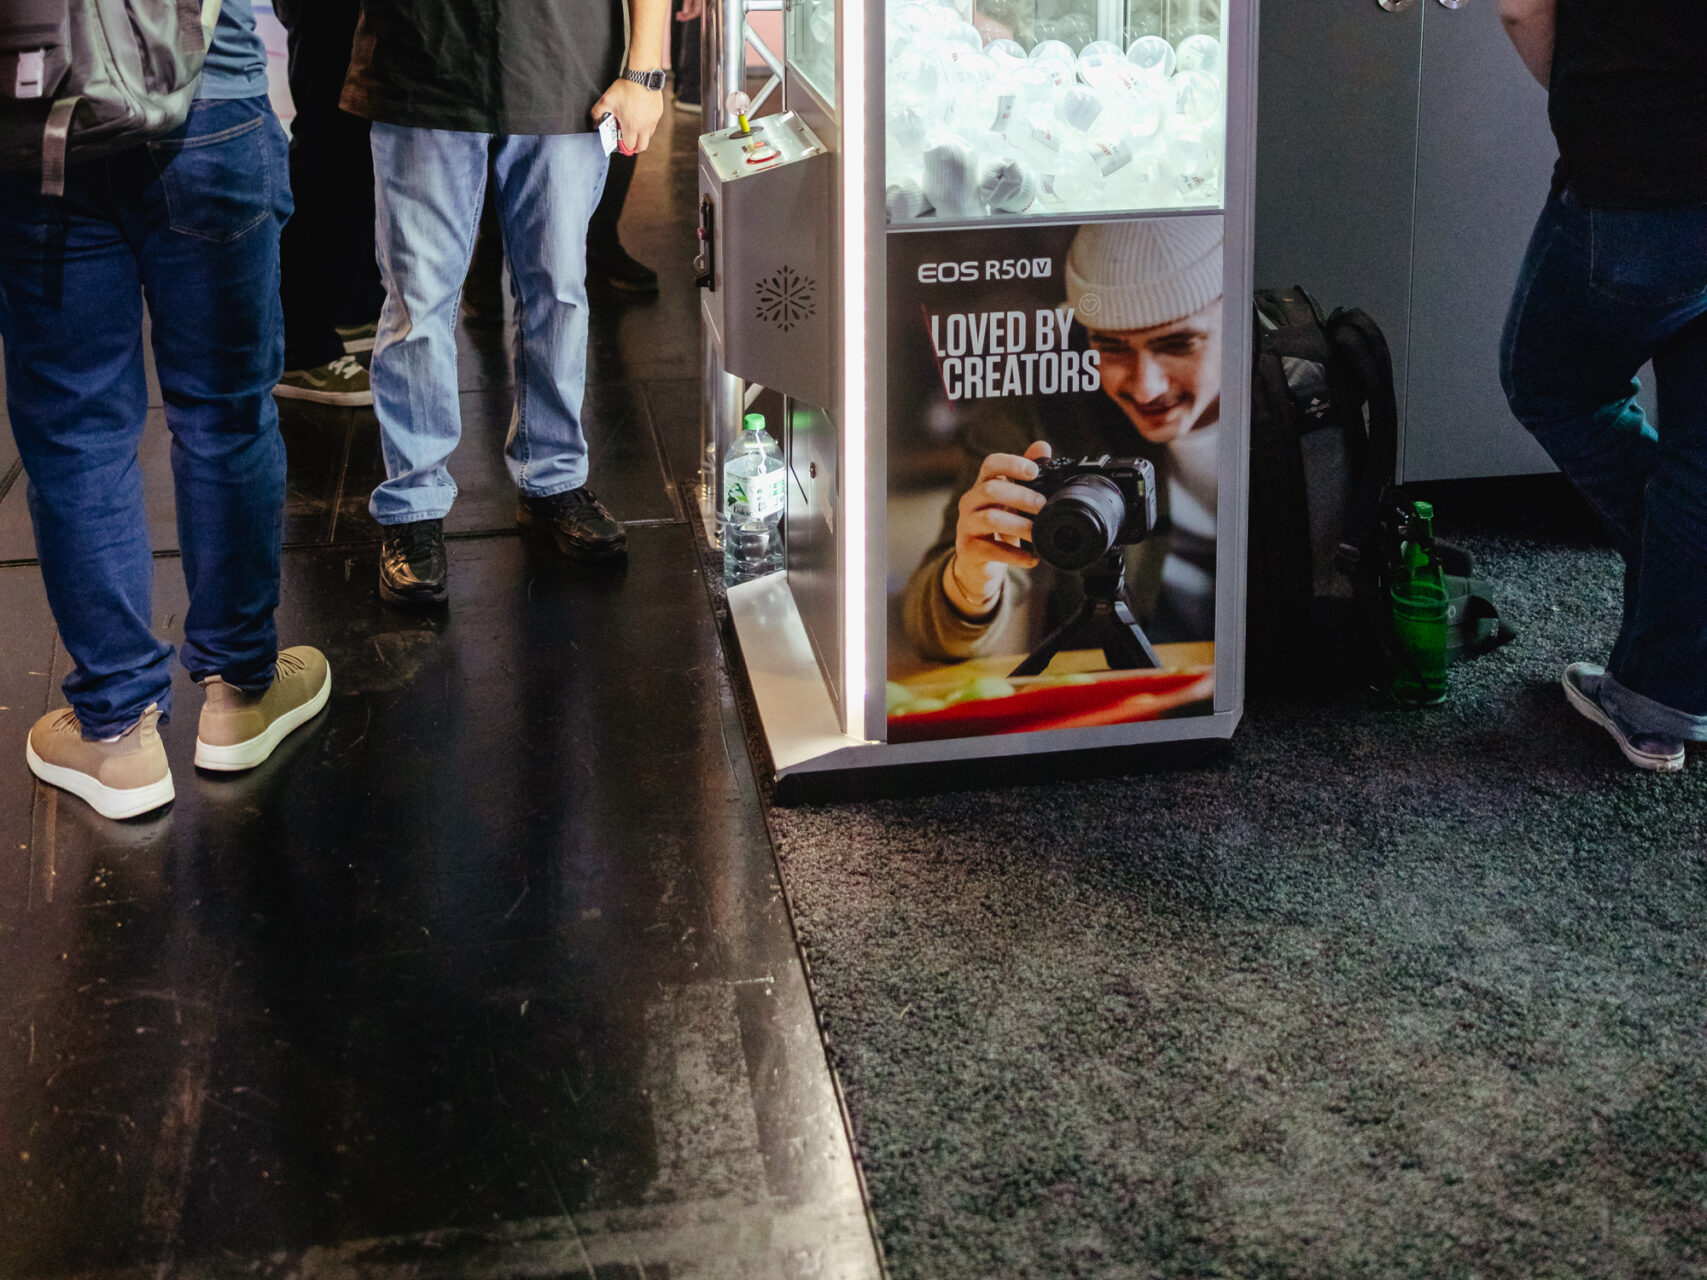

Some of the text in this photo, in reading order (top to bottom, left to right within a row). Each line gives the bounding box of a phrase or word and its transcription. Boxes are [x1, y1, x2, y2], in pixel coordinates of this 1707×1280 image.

[918, 261, 979, 283] EOS
[932, 308, 1075, 357] LOVED BY
[943, 349, 1101, 400] CREATORS
